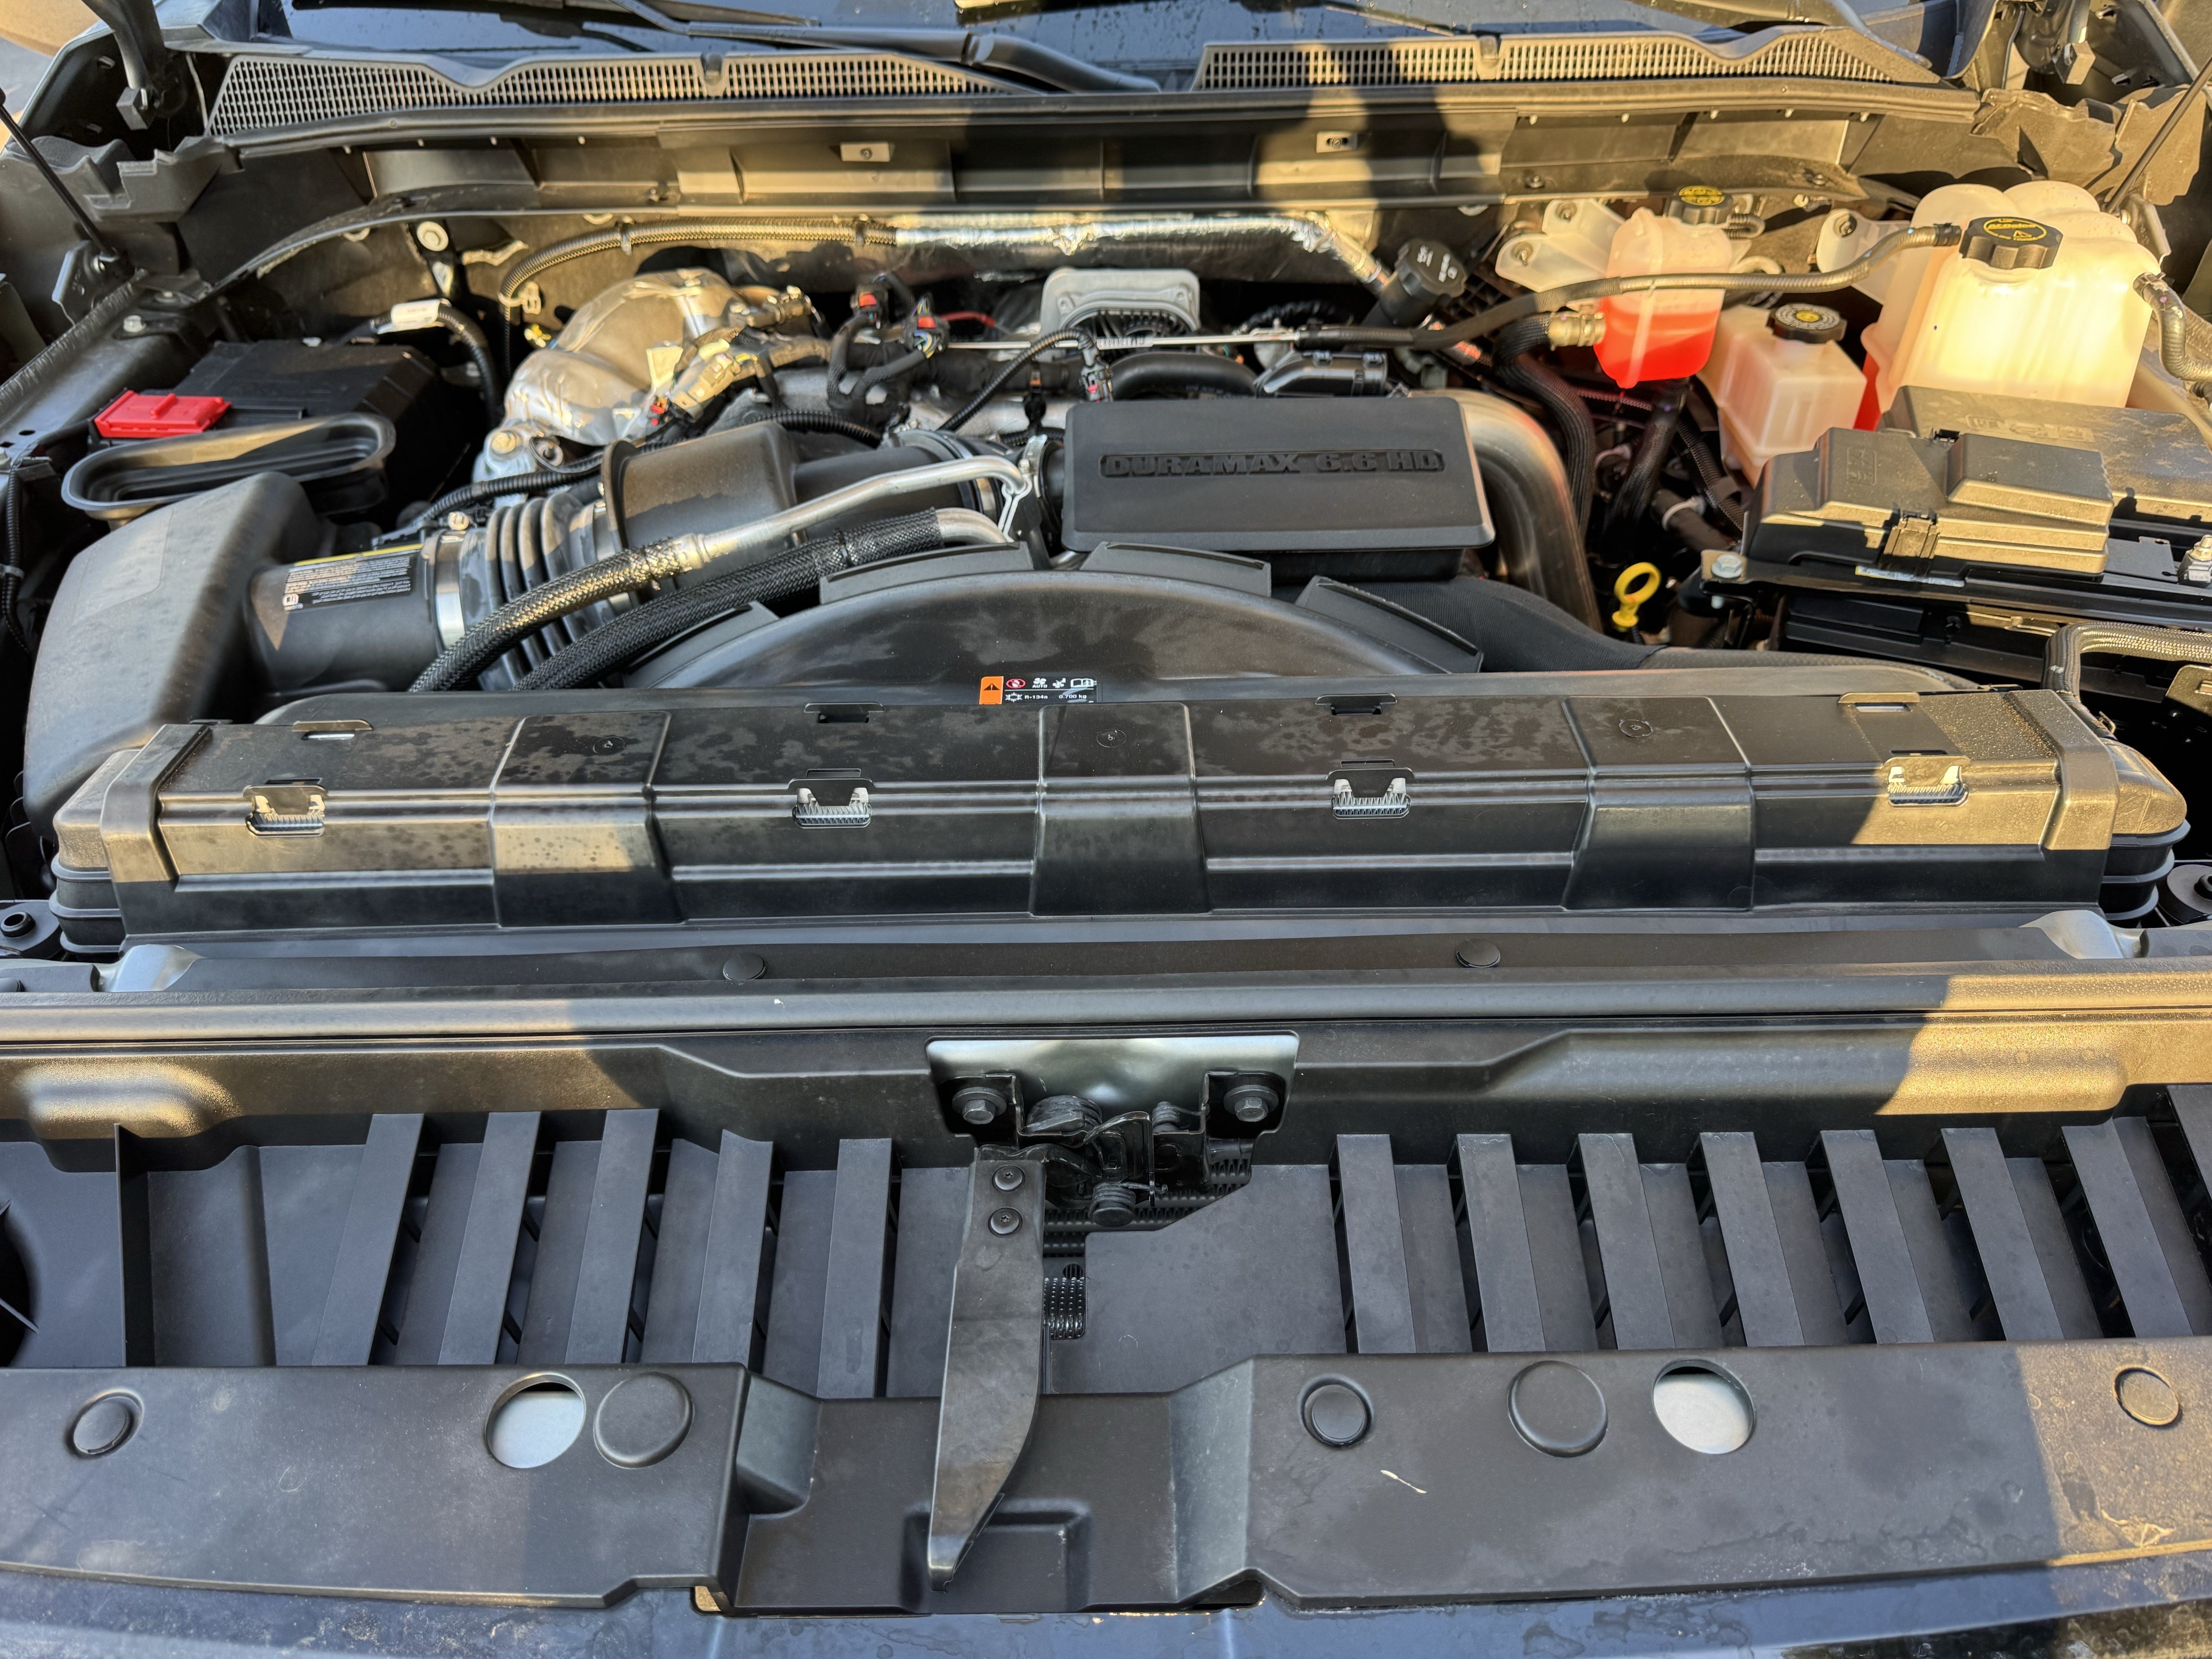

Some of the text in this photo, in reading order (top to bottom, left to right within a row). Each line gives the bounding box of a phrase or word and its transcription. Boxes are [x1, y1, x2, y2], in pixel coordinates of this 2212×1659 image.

[1106, 452, 1439, 477] DURAMAX 6.6 HD
